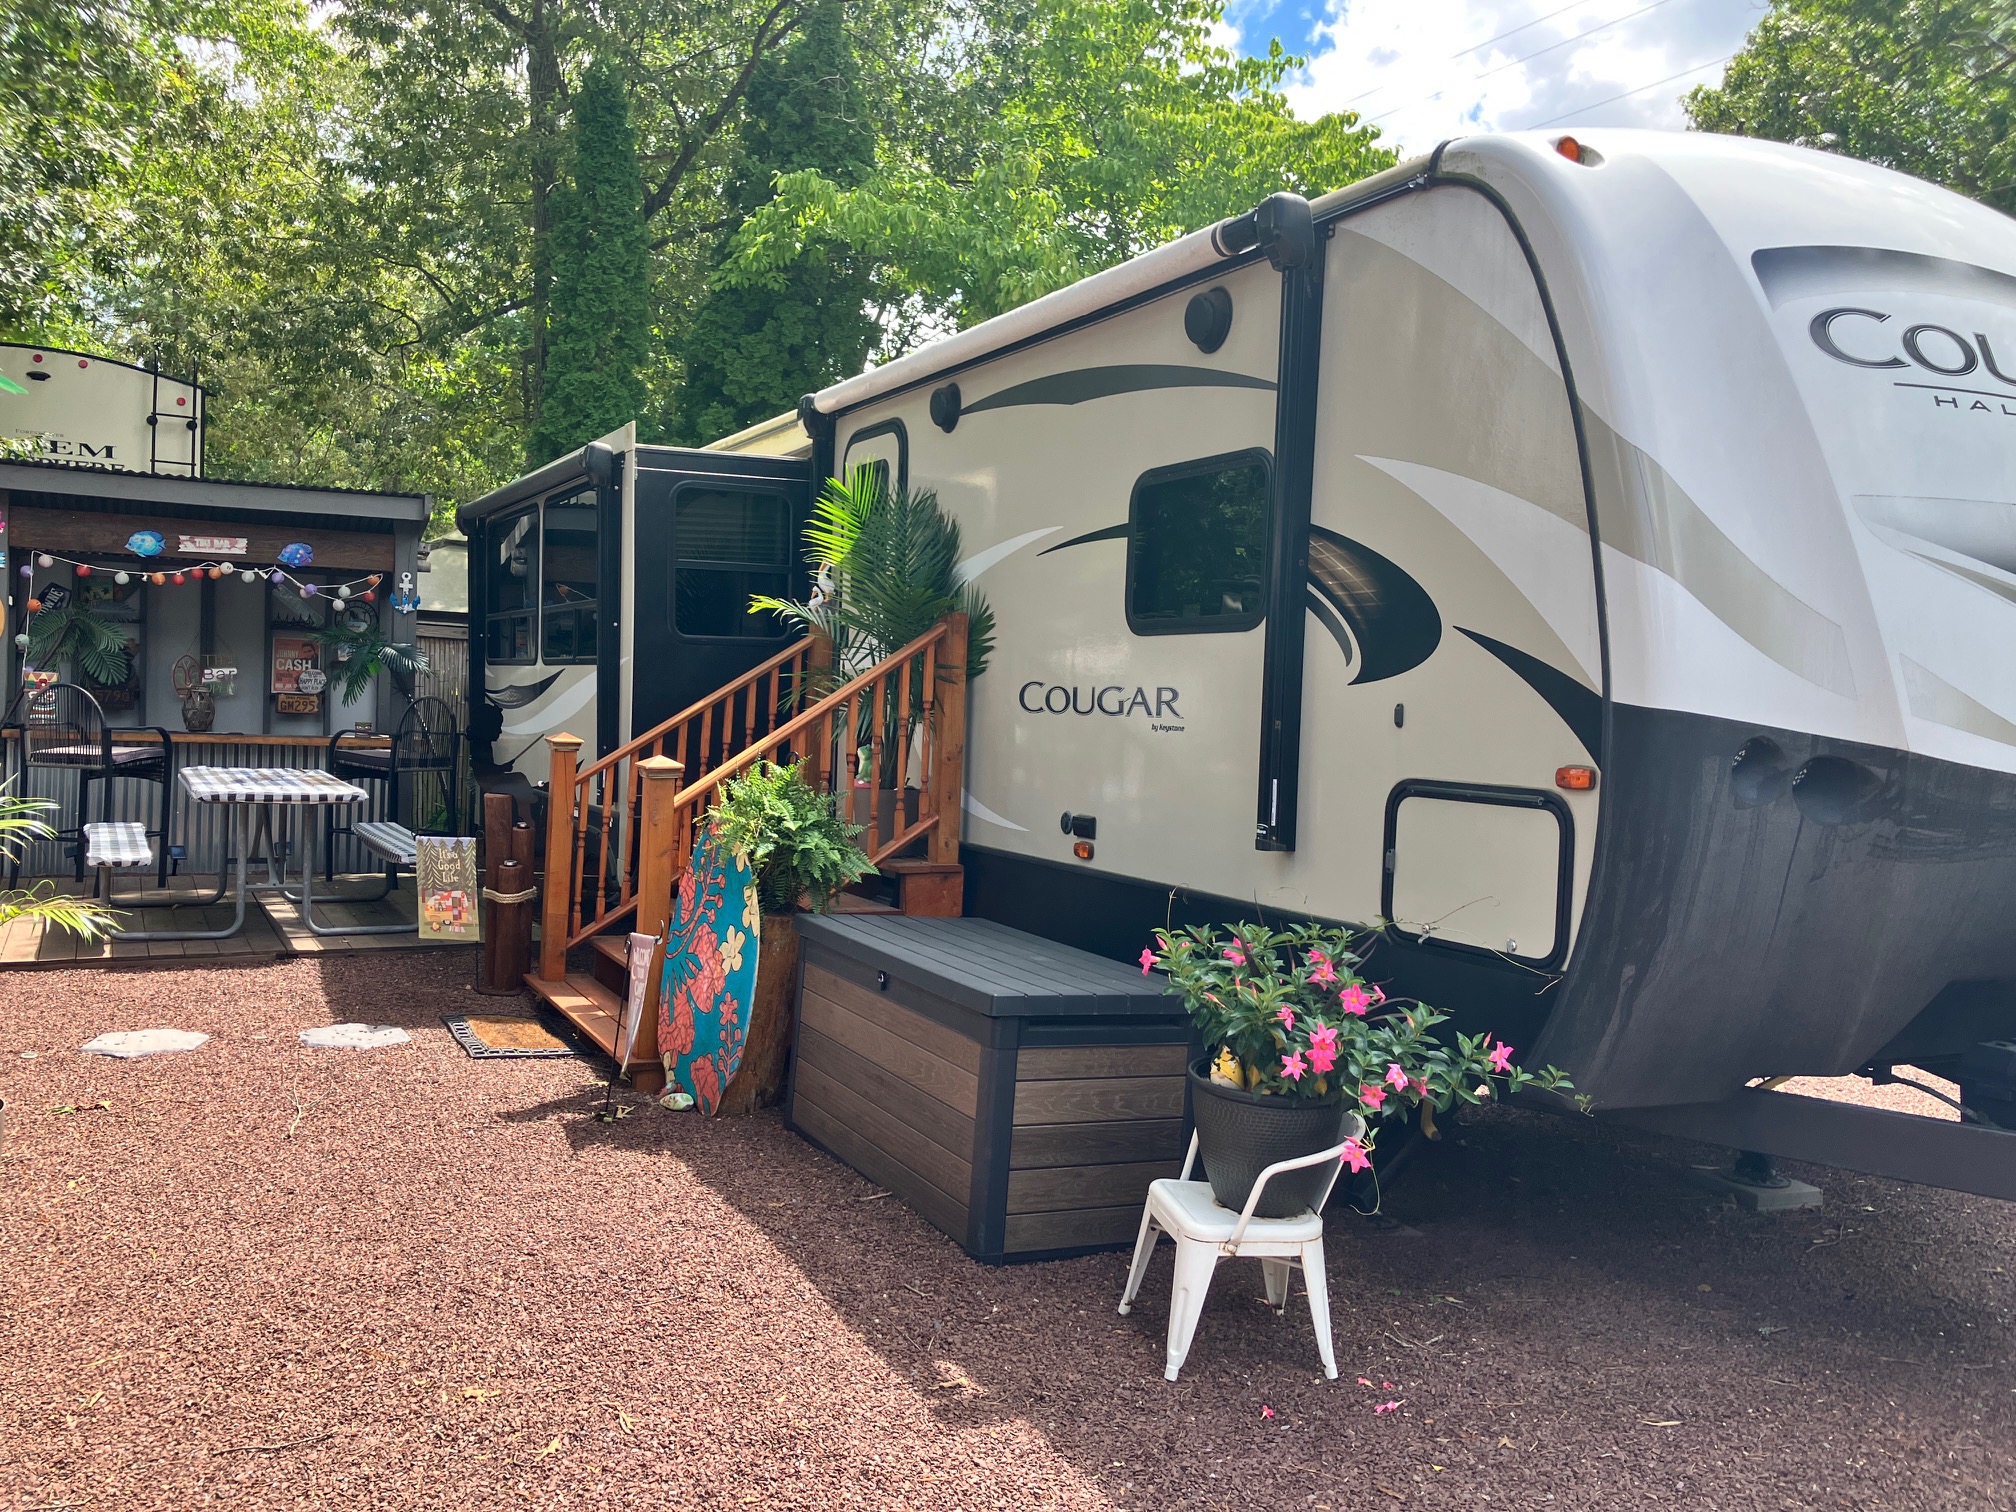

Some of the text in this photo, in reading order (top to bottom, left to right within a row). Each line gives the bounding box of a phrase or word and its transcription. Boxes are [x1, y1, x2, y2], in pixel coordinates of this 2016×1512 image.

[276, 649, 299, 658] JOHNNY
[275, 658, 312, 671] CASH
[1018, 681, 1185, 719] COUGAR
[280, 700, 316, 712] GM295
[1151, 723, 1185, 732] by Keystone
[438, 848, 451, 859] It's
[437, 859, 461, 870] Good
[442, 870, 460, 883] Life
